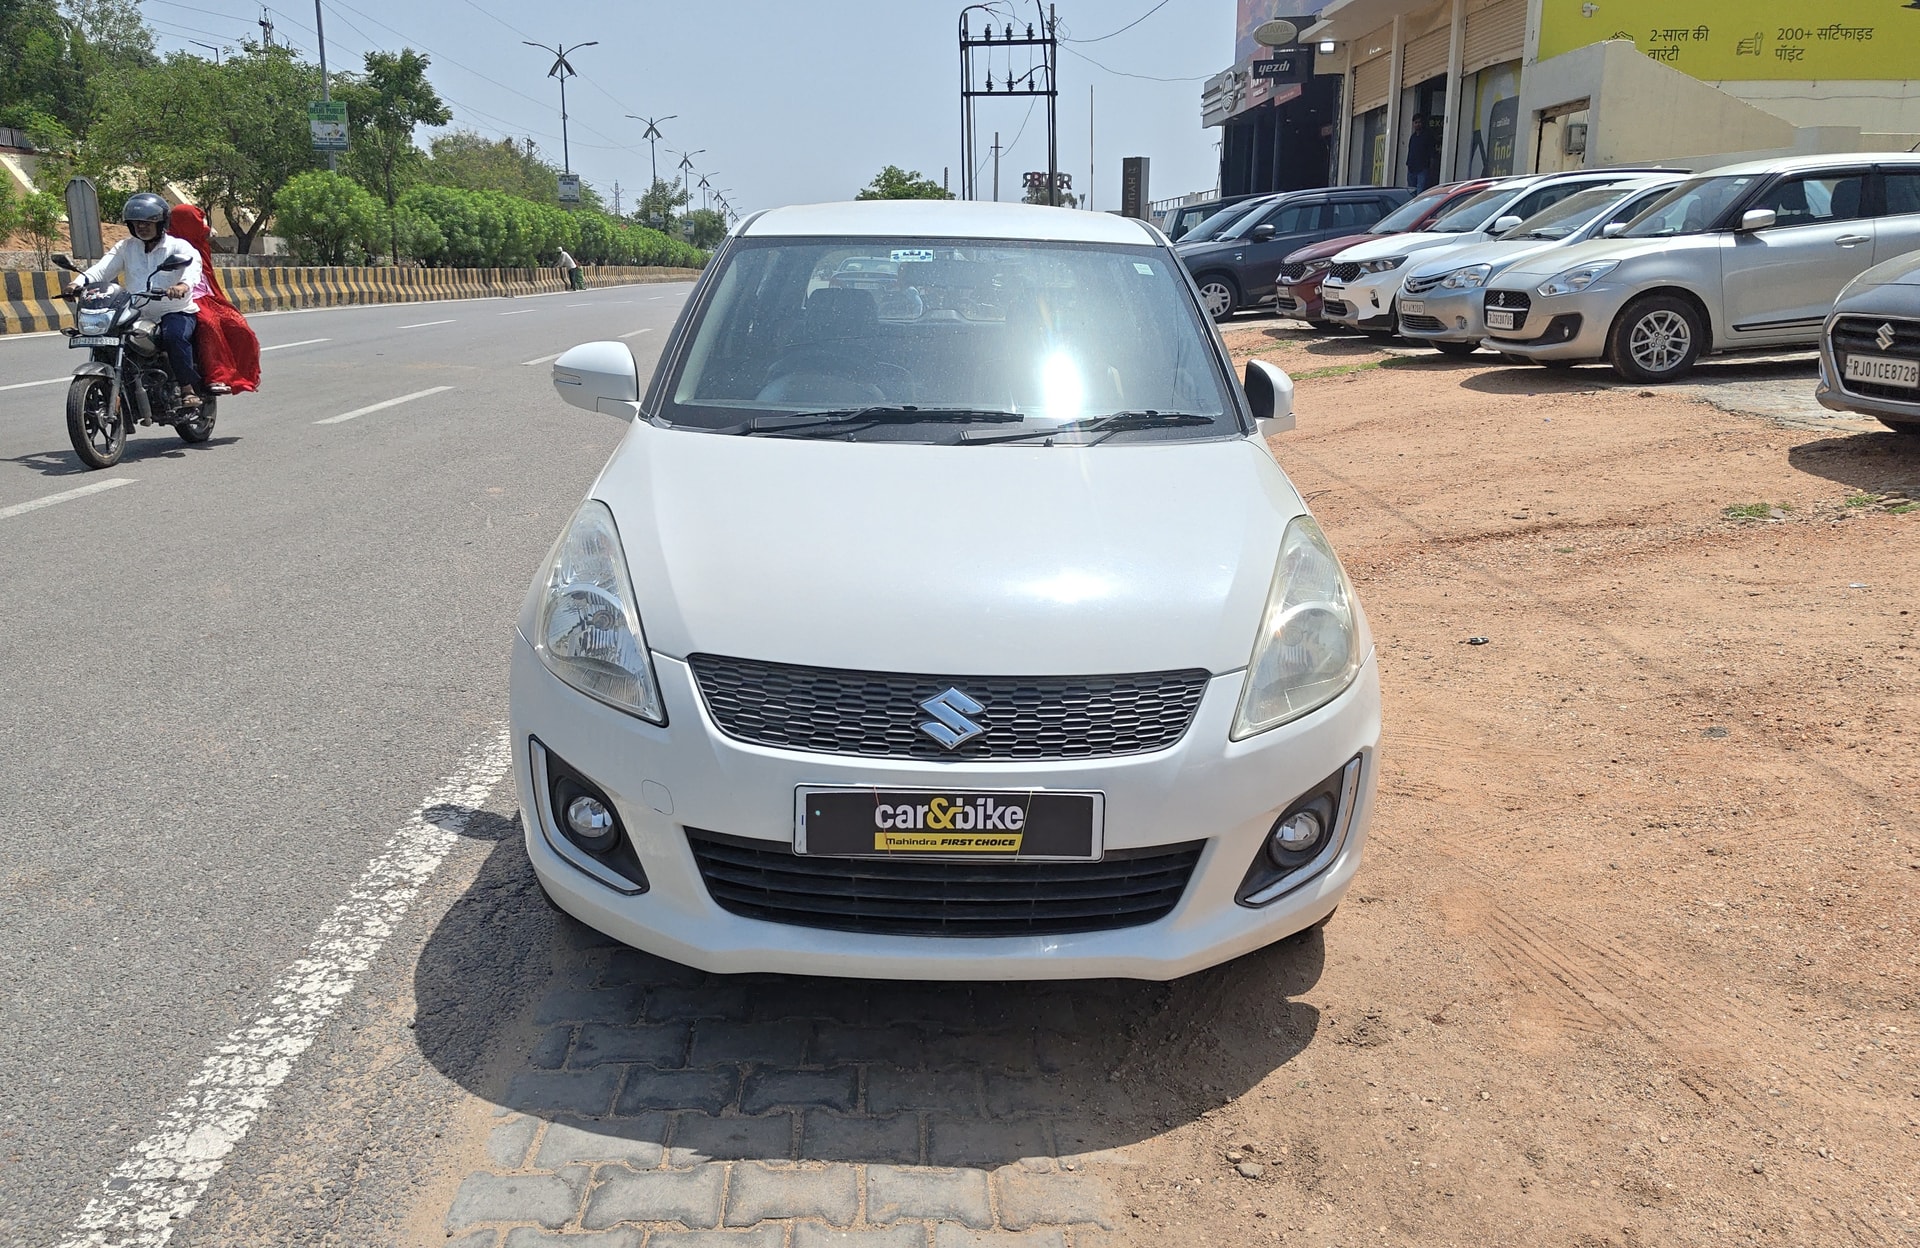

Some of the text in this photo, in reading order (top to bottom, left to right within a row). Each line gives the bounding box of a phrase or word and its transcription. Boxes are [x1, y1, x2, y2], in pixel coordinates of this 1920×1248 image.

[1650, 25, 1710, 42] 2-साल की
[1777, 23, 1874, 42] 200+ सर्टिफाइड
[1647, 44, 1681, 61] वारंटी
[1775, 44, 1805, 63] पॉइंट
[1258, 60, 1290, 75] yezdi
[1494, 139, 1513, 160] find
[1853, 360, 1917, 382] RJ01CE8728
[874, 797, 1024, 830] car&bike
[886, 838, 1017, 847] Mahindra FIRST CHOICE
